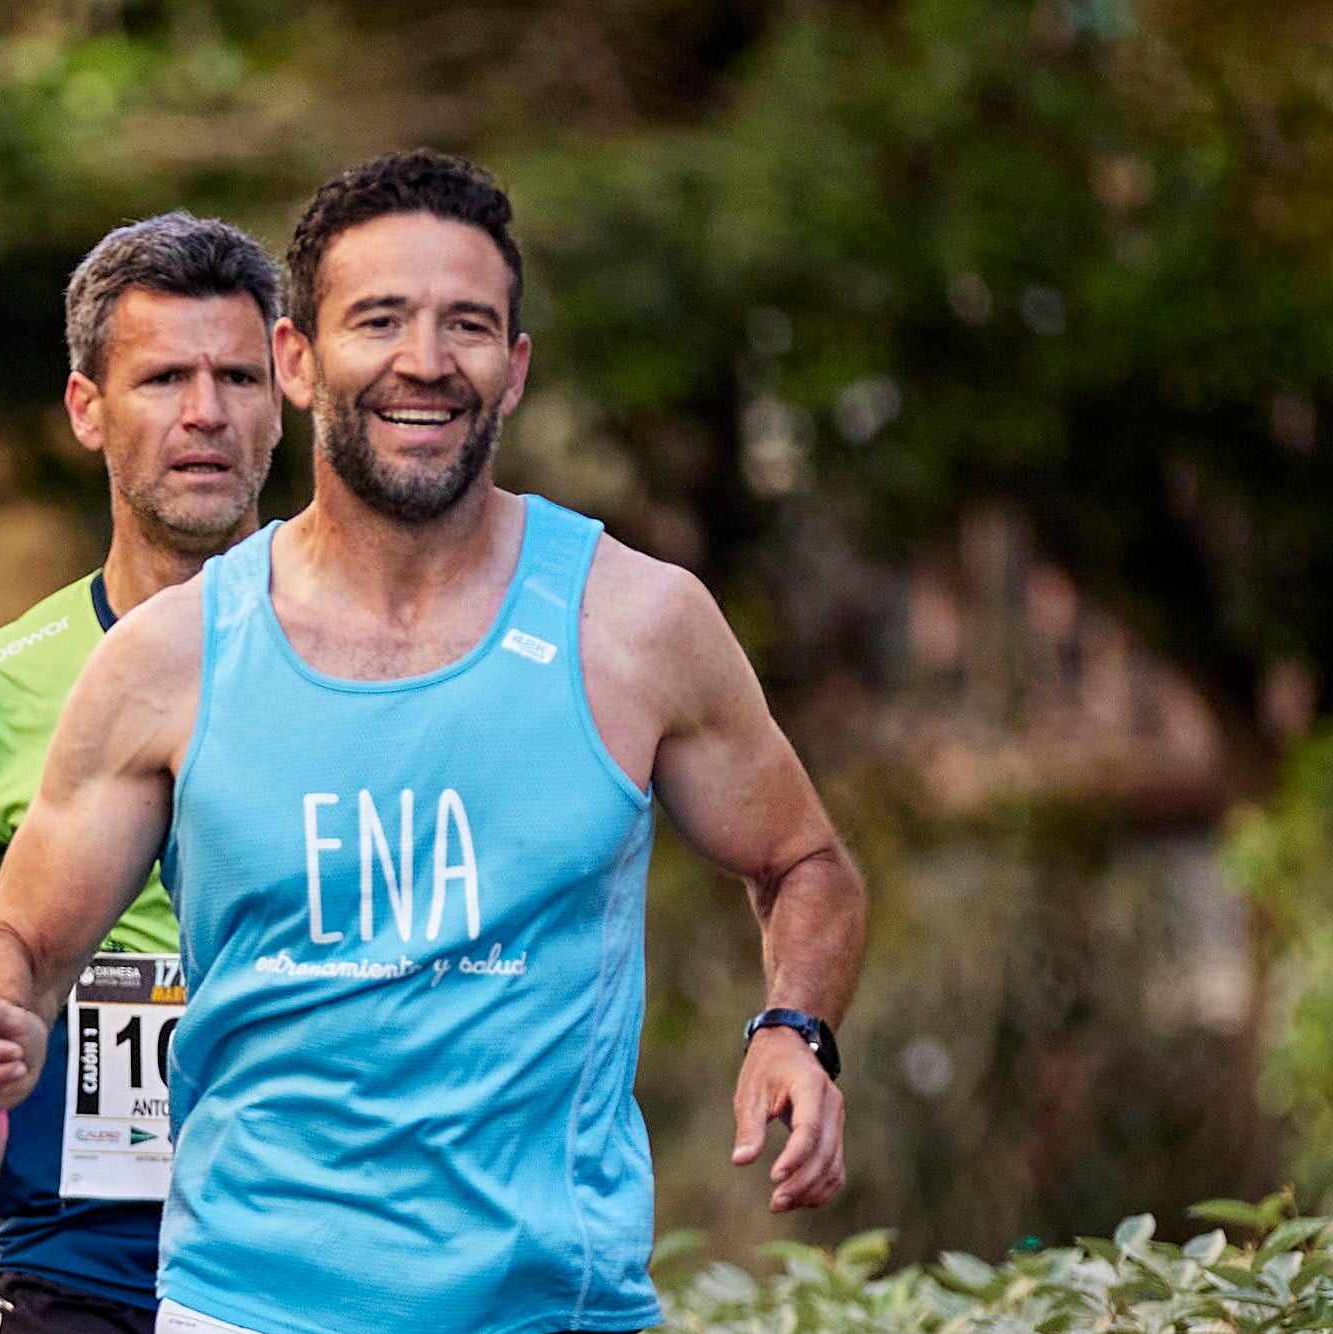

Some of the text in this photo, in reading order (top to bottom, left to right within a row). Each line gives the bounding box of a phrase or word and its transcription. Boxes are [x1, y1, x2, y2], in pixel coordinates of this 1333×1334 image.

[302, 788, 482, 945] ENA
[154, 960, 180, 987] 17
[433, 959, 450, 987] y
[459, 943, 527, 976] salud
[81, 1042, 99, 1094] CAJÓN
